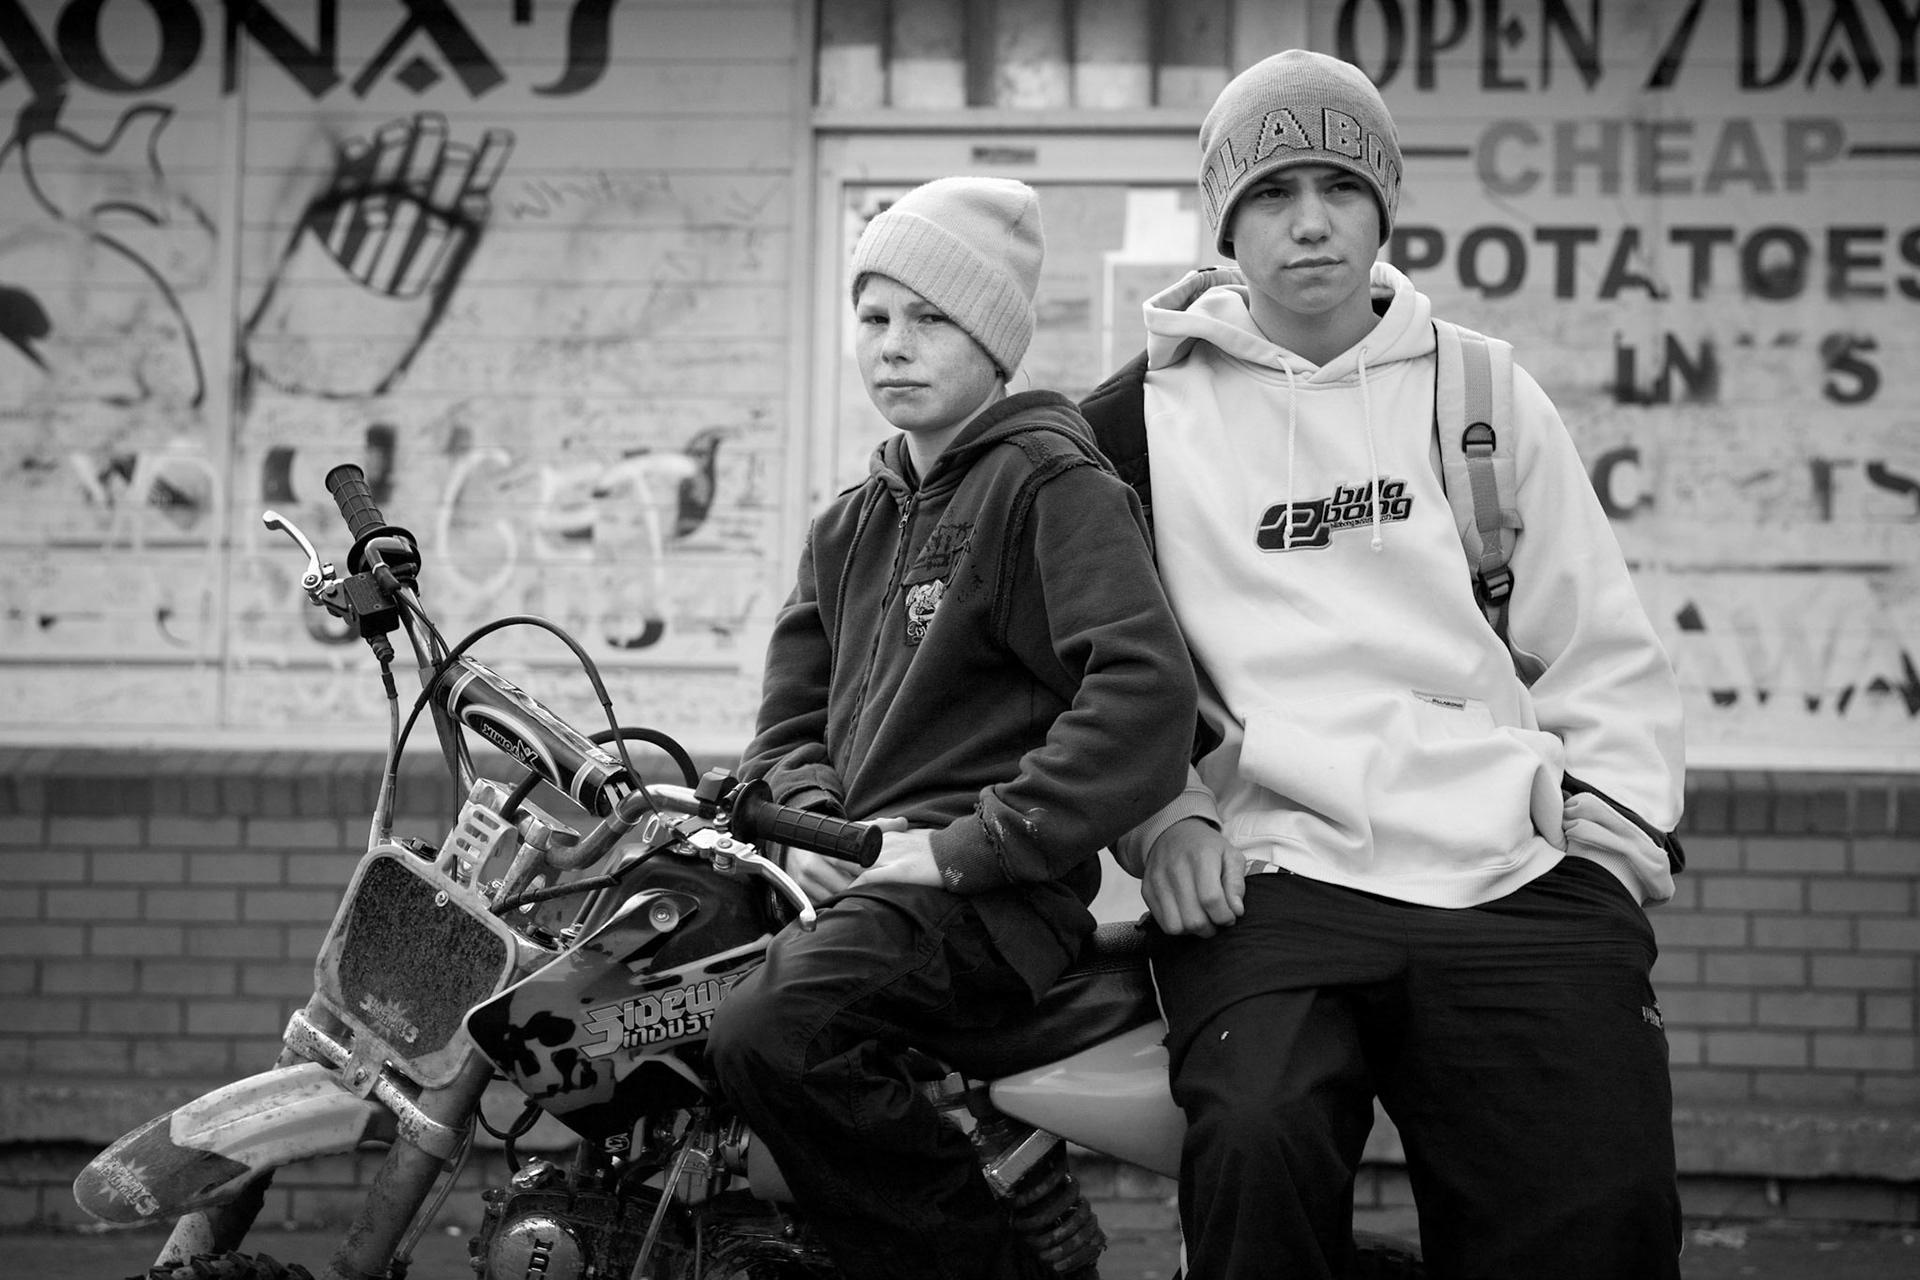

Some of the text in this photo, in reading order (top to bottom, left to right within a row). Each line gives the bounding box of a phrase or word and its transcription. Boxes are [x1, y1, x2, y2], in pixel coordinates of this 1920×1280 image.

[1335, 0, 1605, 91] OPEN
[1475, 117, 1848, 196] CHEAP
[1322, 498, 1412, 523] bong
[482, 723, 538, 772] ATOMIK
